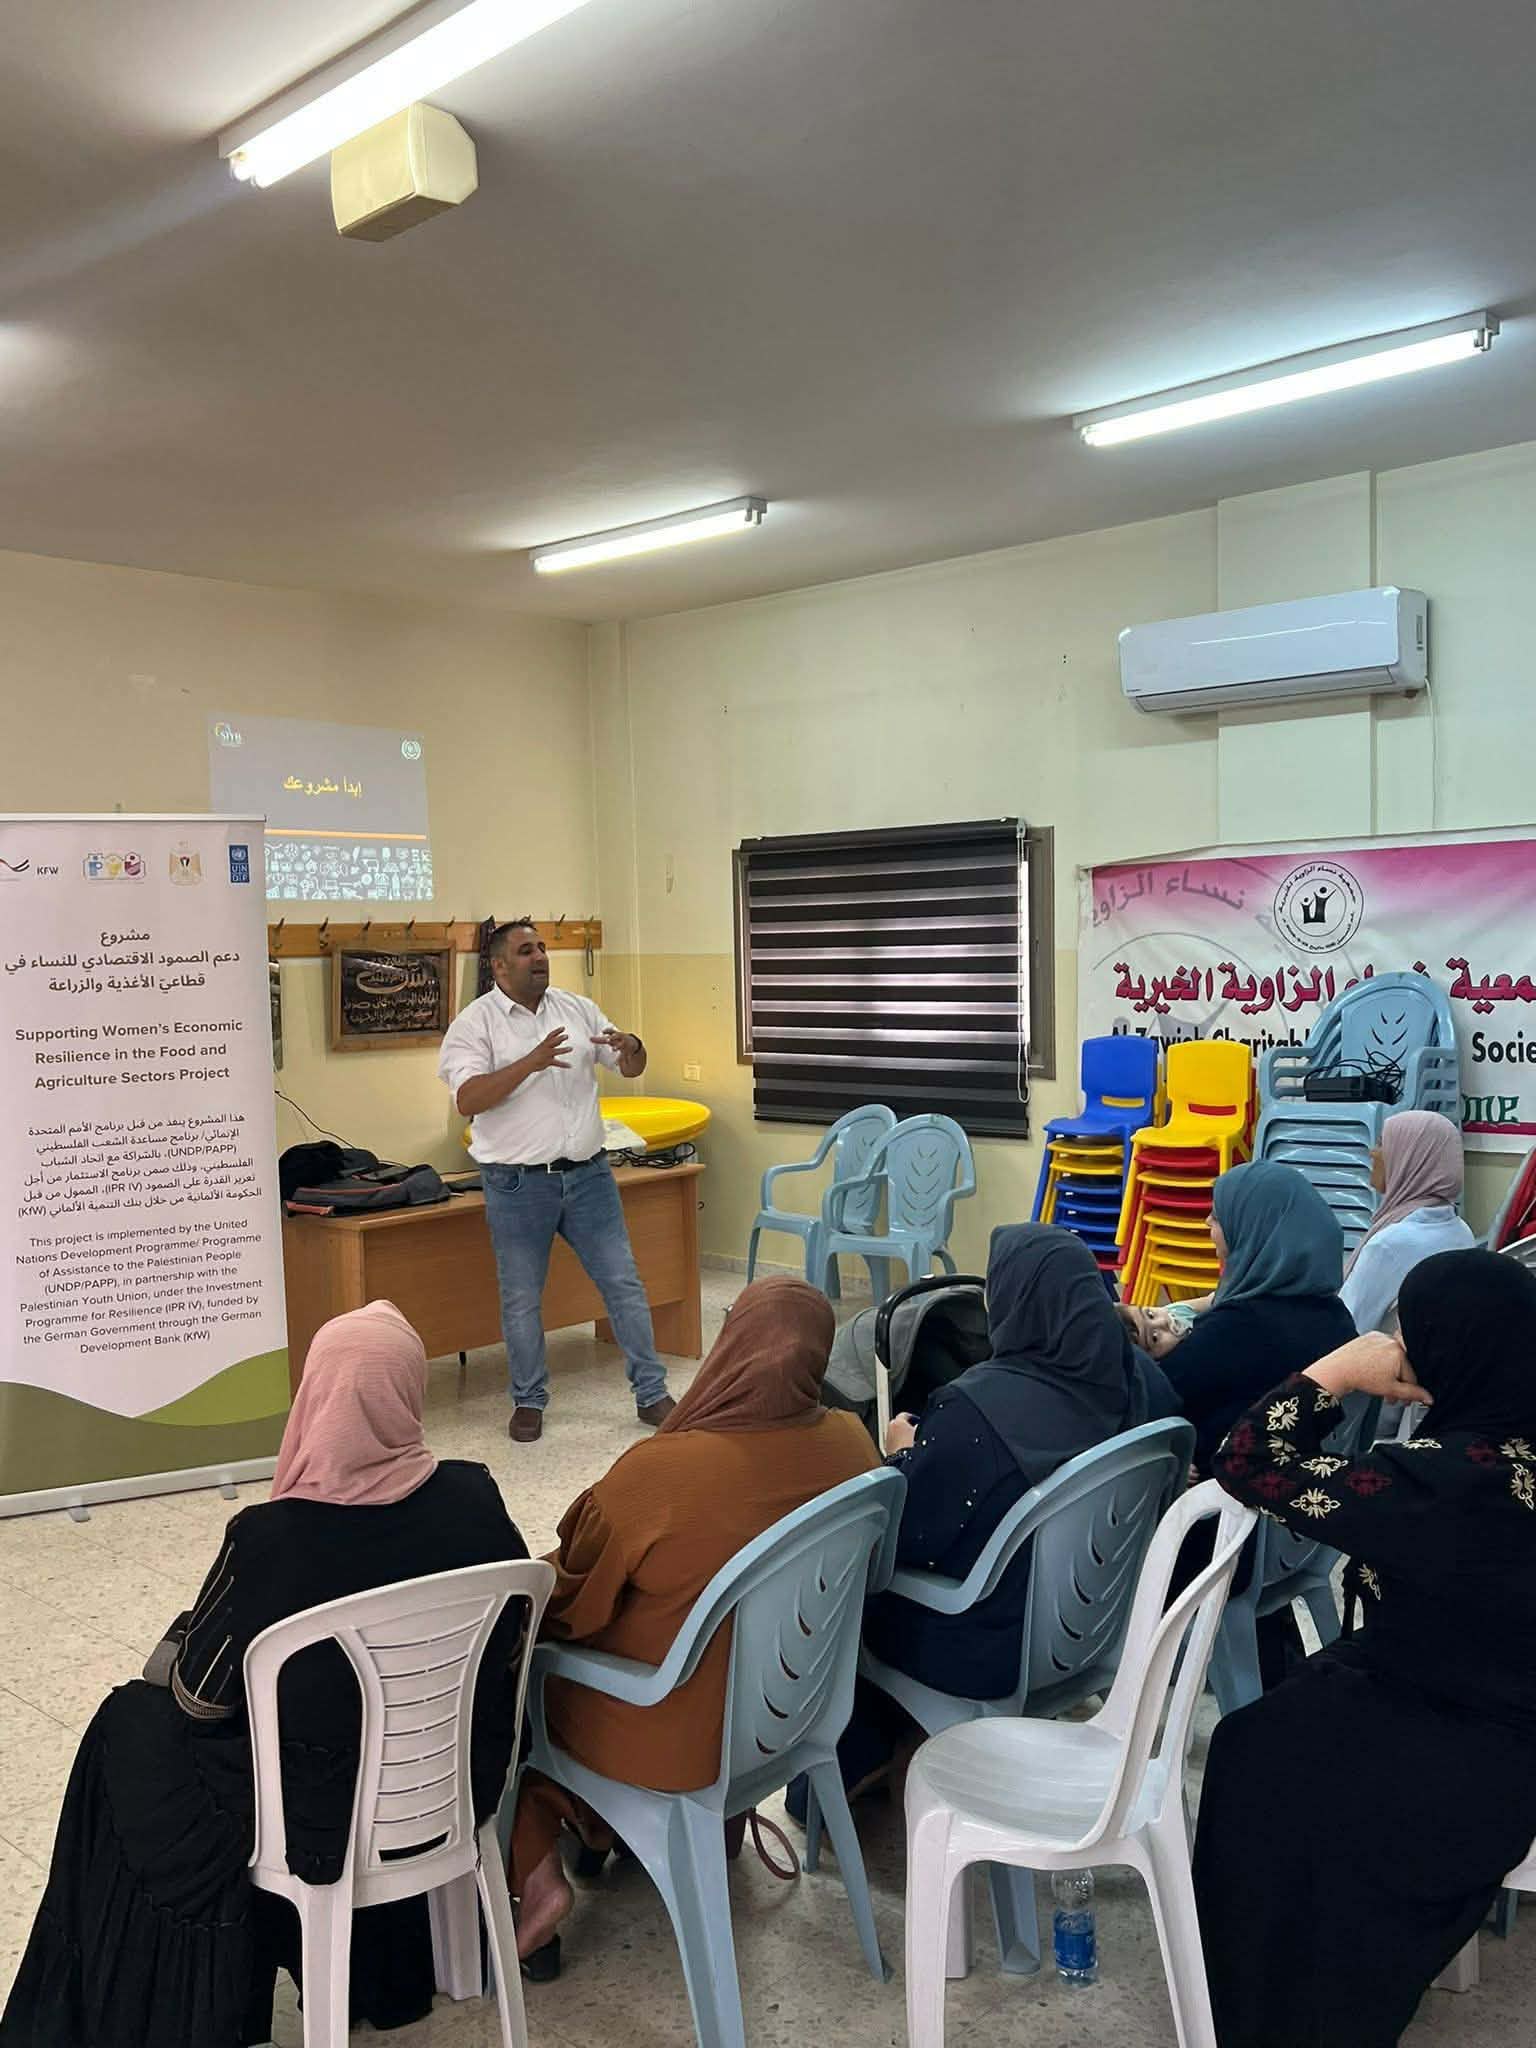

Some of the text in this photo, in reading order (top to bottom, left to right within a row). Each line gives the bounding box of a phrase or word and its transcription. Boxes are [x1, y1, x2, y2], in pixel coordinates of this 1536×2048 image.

[1093, 869, 1245, 927] نساء الزاوي
[100, 928, 151, 947] مشروع
[5, 950, 240, 975] دعم الصمود الاقتصادي للنساء في
[49, 977, 103, 994] والزراعة
[107, 974, 155, 993] الأغذية
[1113, 960, 1214, 1015] الخيرية
[1217, 962, 1336, 1015] الزاوية
[1444, 957, 1536, 1015] معية
[15, 1026, 98, 1042] Supporting
[174, 1019, 243, 1034] Economic
[35, 1043, 227, 1064] Resilience in the Food and
[1471, 1030, 1536, 1064] Socie
[35, 1067, 230, 1091] Agriculture Sectors Project
[68, 1121, 92, 1136] الأمم
[95, 1121, 124, 1135] برنامج
[127, 1119, 145, 1132] قبل
[148, 1120, 163, 1130] من
[188, 1114, 227, 1129] المشروع
[28, 1123, 66, 1136] المتحدة
[92, 1135, 128, 1147] الشعب
[130, 1134, 167, 1145] مساعدة
[169, 1132, 198, 1145] برنامج
[36, 1138, 89, 1154] الفلسطيني
[41, 1155, 78, 1168] الشباب
[106, 1154, 120, 1166] مع
[122, 1149, 160, 1162] بالشراكة
[110, 1168, 140, 1181] برنامج
[144, 1166, 170, 1177] ضمن
[172, 1162, 197, 1174] وذلك
[47, 1174, 62, 1185] من
[65, 1168, 109, 1183] الاستثمار
[204, 1174, 231, 1187] القدرة
[145, 1178, 181, 1192] الصمود
[183, 1177, 201, 1189] على
[23, 1189, 43, 1202] قبل
[45, 1190, 61, 1201] من
[63, 1185, 98, 1199] الممول
[187, 1190, 224, 1204] الألمانية
[225, 1187, 262, 1200] الحكومة
[88, 1199, 120, 1211] التنمية
[122, 1197, 142, 1208] بنك
[168, 1196, 185, 1206] من
[49, 1200, 85, 1217] الألماني
[29, 1219, 248, 1248] This project is implemented by the United
[16, 1253, 58, 1265] Nations
[60, 1245, 132, 1261] Development
[202, 1234, 262, 1248] Programme
[39, 1250, 241, 1279] of Assistance to the Palestinian People
[123, 1277, 132, 1286] in
[135, 1271, 194, 1286] partnership
[197, 1267, 218, 1279] with
[221, 1266, 238, 1276] the
[20, 1279, 262, 1313] Palestinian Youth Union, under the Investment
[25, 1313, 88, 1329] Programme
[91, 1311, 106, 1321] for
[108, 1305, 162, 1319] Resilience
[165, 1302, 186, 1315] (IPR
[207, 1296, 243, 1308] funded
[246, 1295, 259, 1305] by
[23, 1310, 262, 1345] the German Government through the German
[80, 1337, 152, 1354] Development
[154, 1334, 181, 1345] Bank
